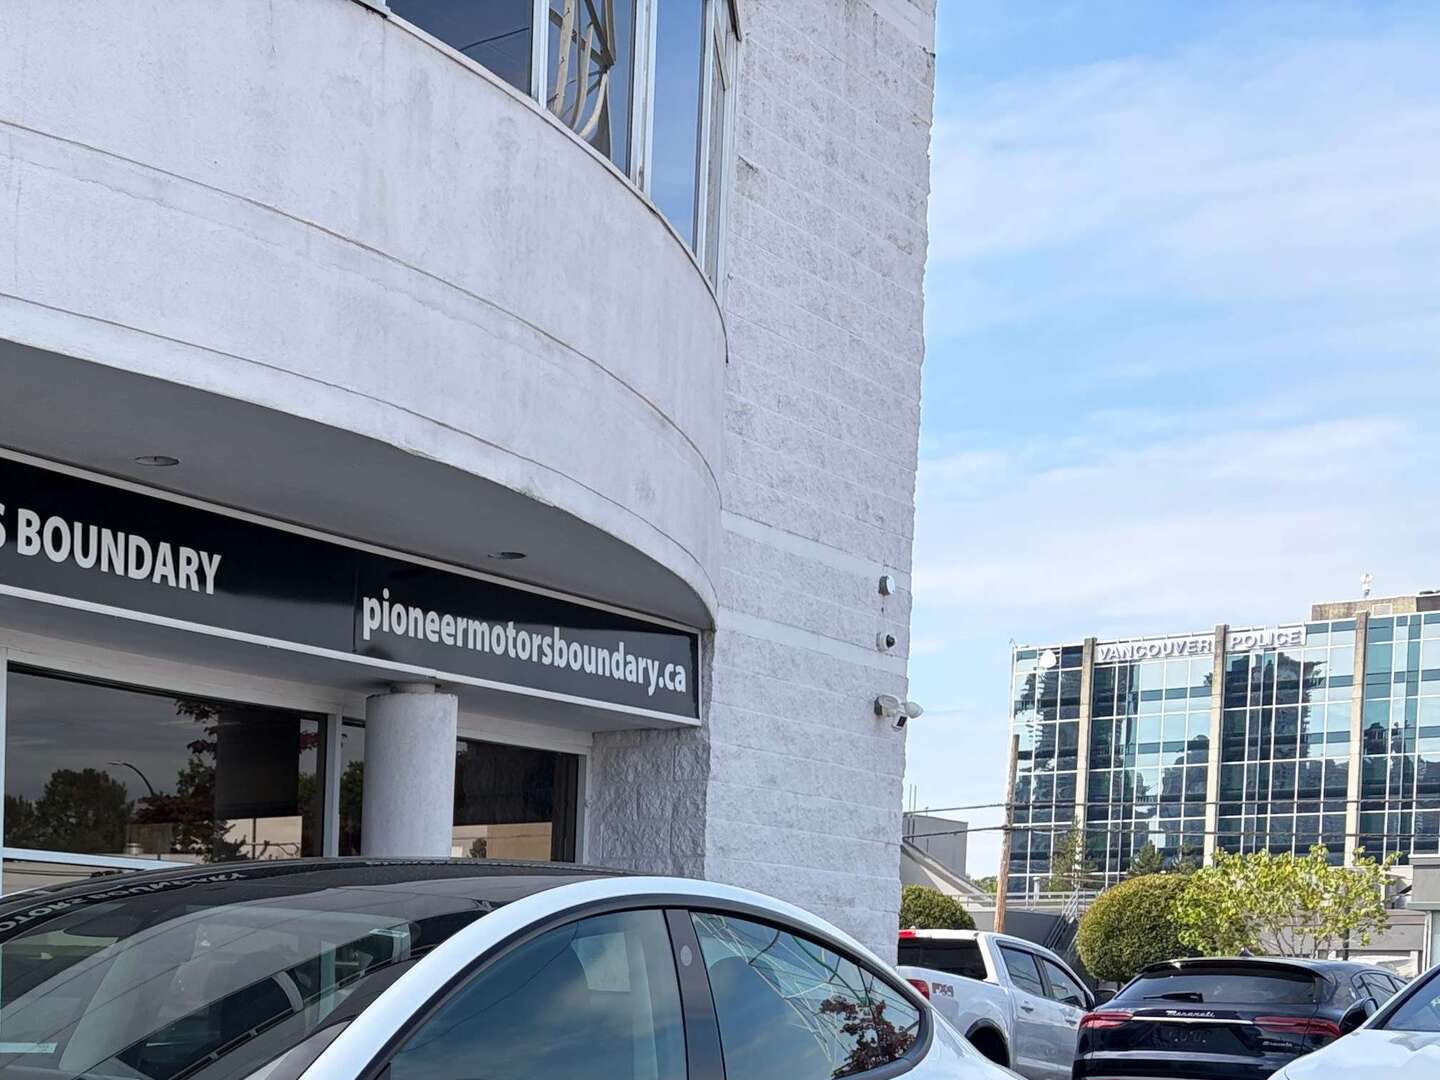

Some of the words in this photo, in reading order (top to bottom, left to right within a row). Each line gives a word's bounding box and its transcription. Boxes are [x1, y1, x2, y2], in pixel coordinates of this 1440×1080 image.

[16, 507, 222, 596] BOUNDARY
[362, 588, 687, 696] pioneermotorsboundary.ca
[1097, 638, 1211, 661] VANCOUVER
[1230, 629, 1303, 649] POLICE
